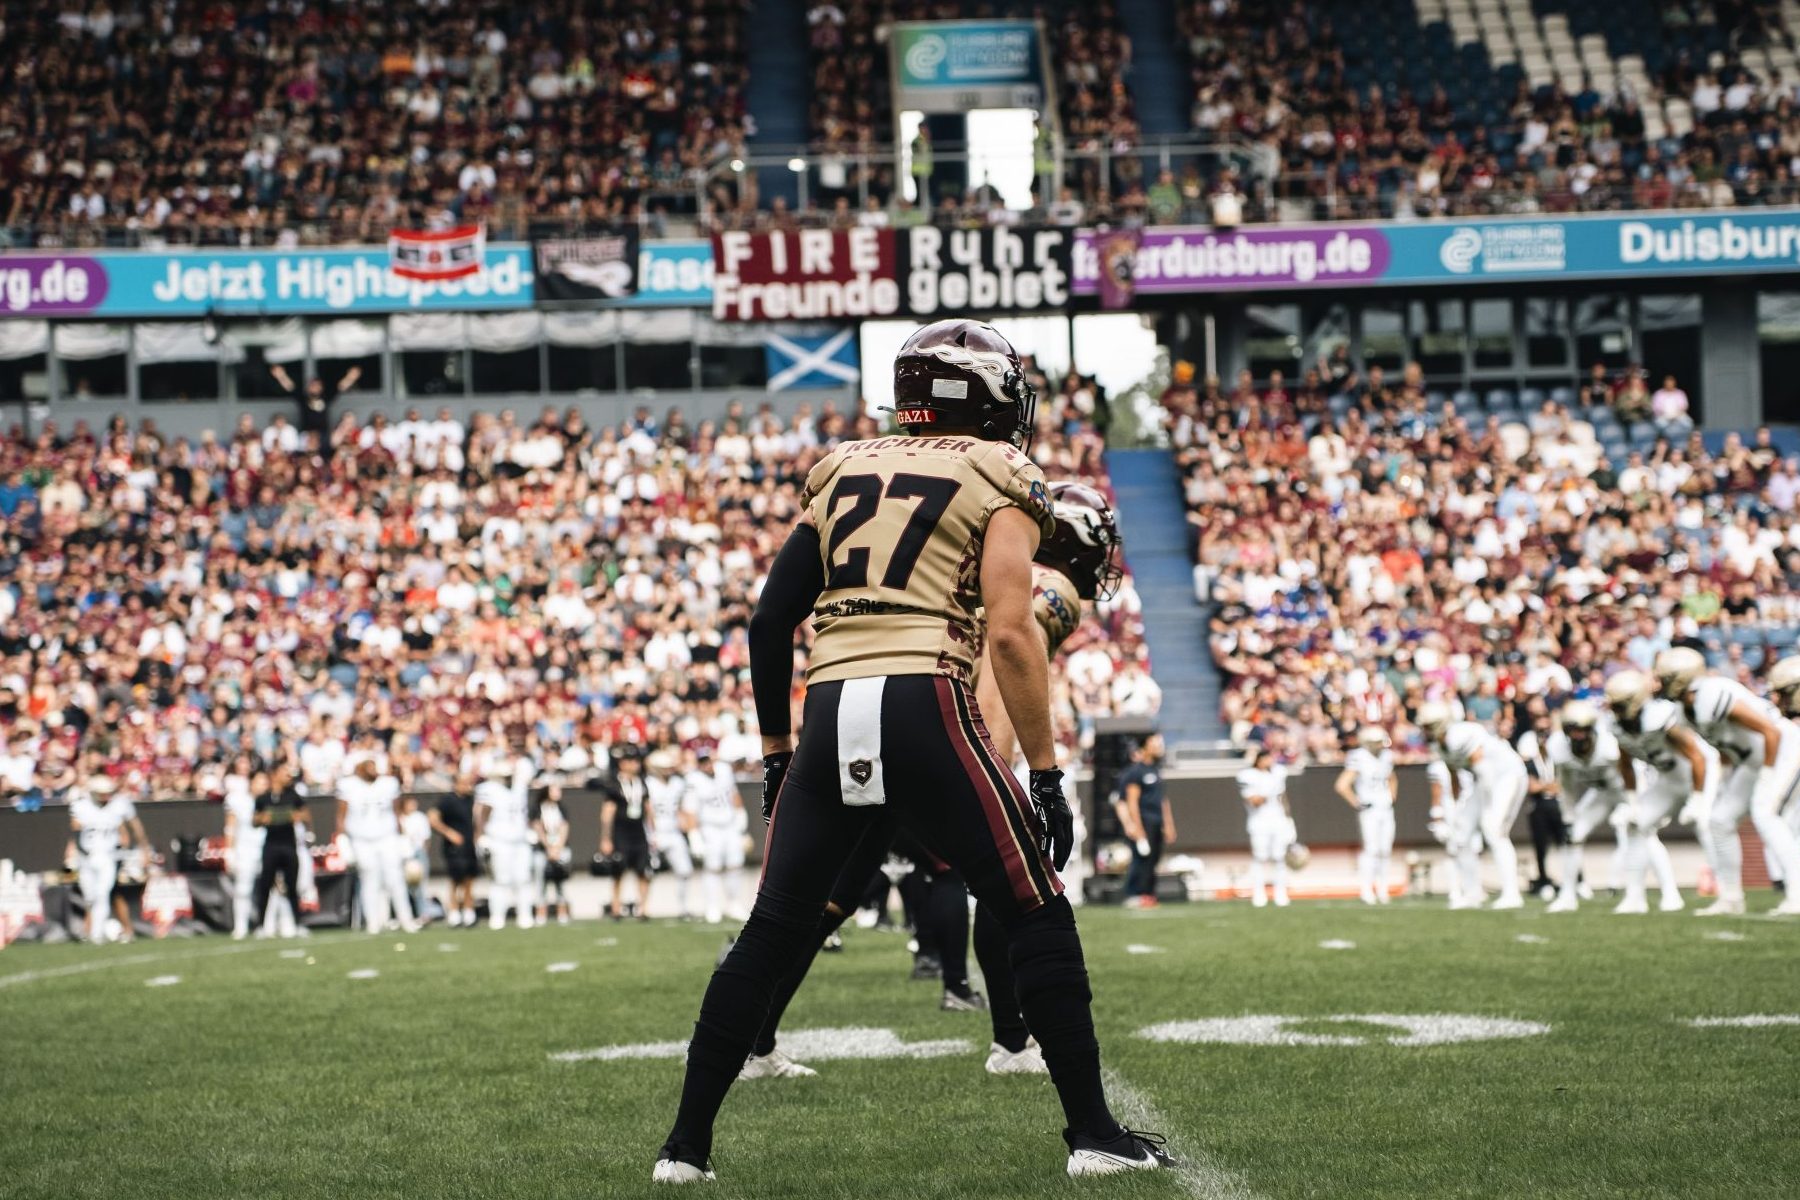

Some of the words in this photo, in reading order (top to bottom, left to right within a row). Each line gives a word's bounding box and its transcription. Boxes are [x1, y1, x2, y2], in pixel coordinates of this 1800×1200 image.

[722, 228, 880, 274] FIRE
[909, 224, 1064, 269] Ruhr
[1620, 218, 1800, 263] Duisbur
[153, 258, 265, 301] Jetzt
[713, 272, 899, 320] Freunde
[908, 259, 1068, 315] gebiet
[845, 437, 976, 454] RICHTER
[826, 472, 962, 591] 27
